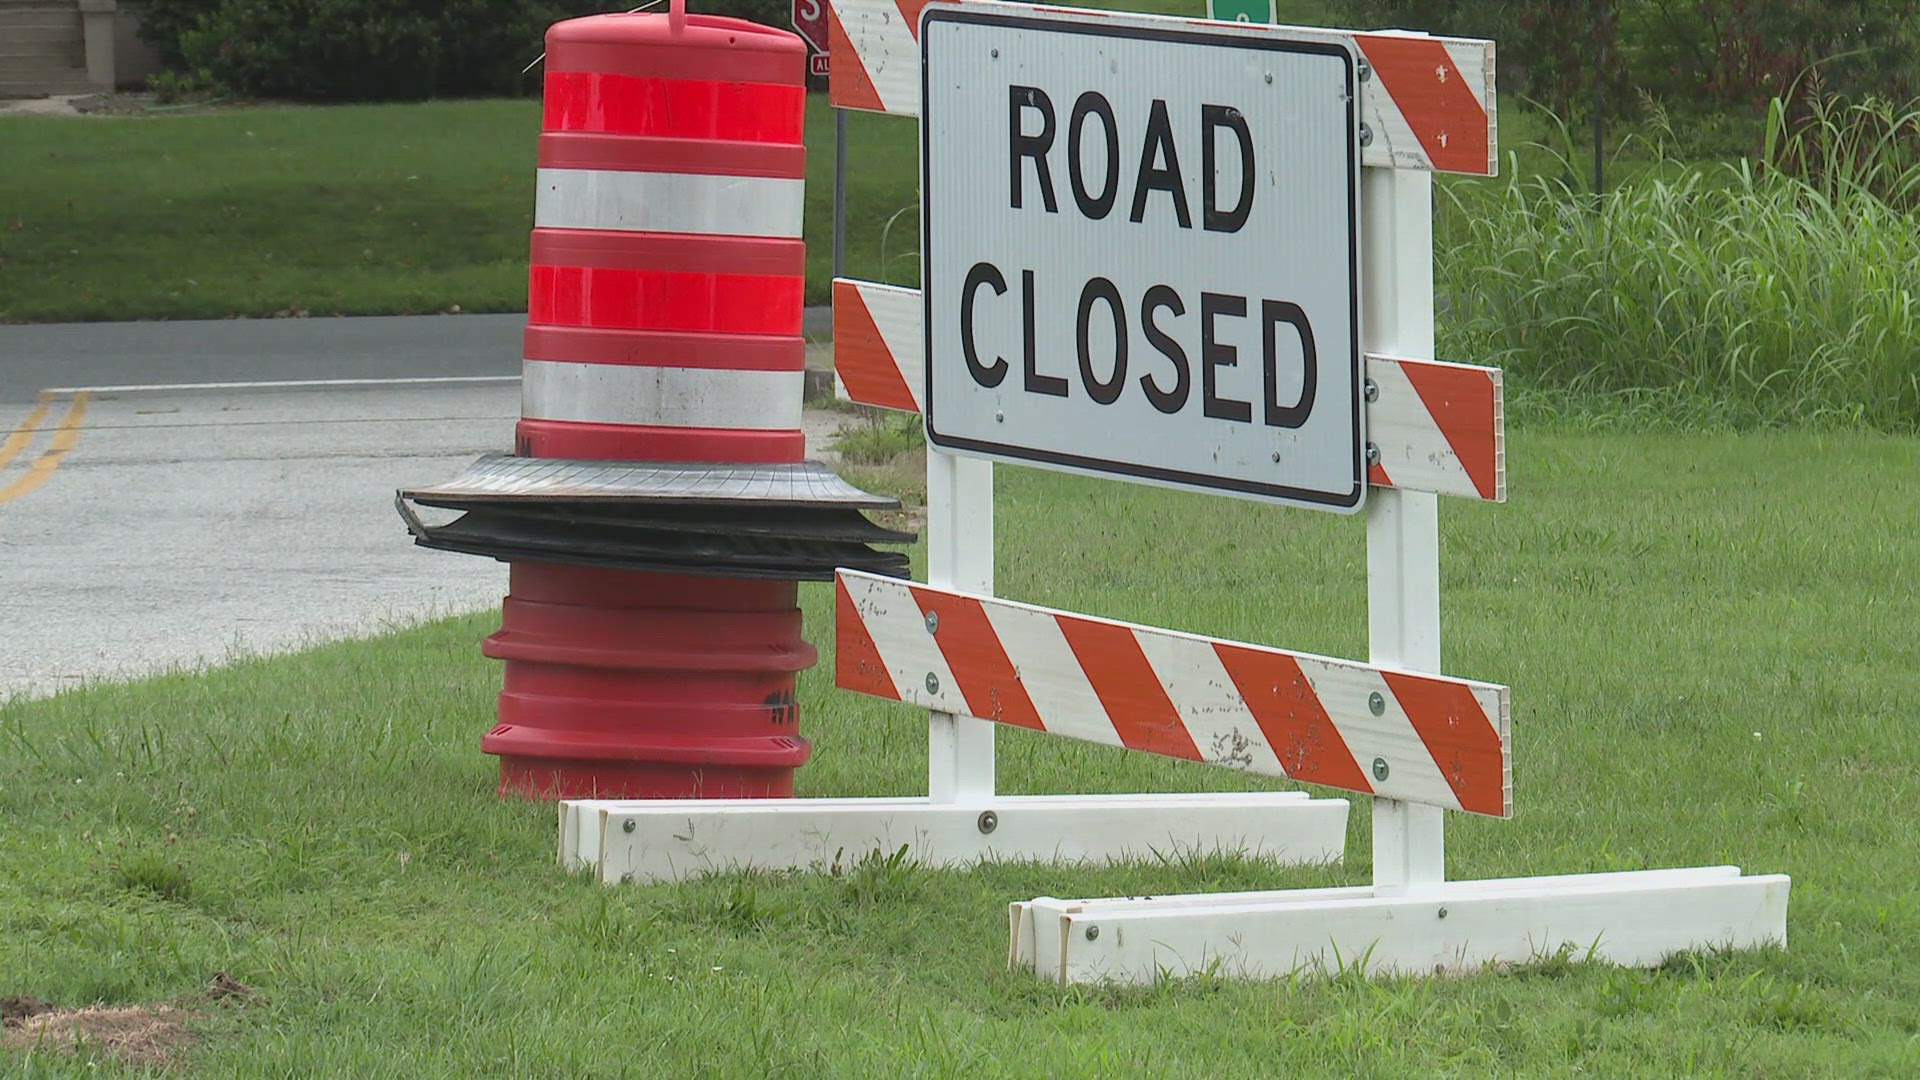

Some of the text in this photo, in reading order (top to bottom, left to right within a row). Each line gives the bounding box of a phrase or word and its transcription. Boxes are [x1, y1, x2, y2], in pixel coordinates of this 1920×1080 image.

[816, 58, 829, 71] AL
[1009, 84, 1256, 233] ROAD
[961, 262, 1318, 429] CLOSED
